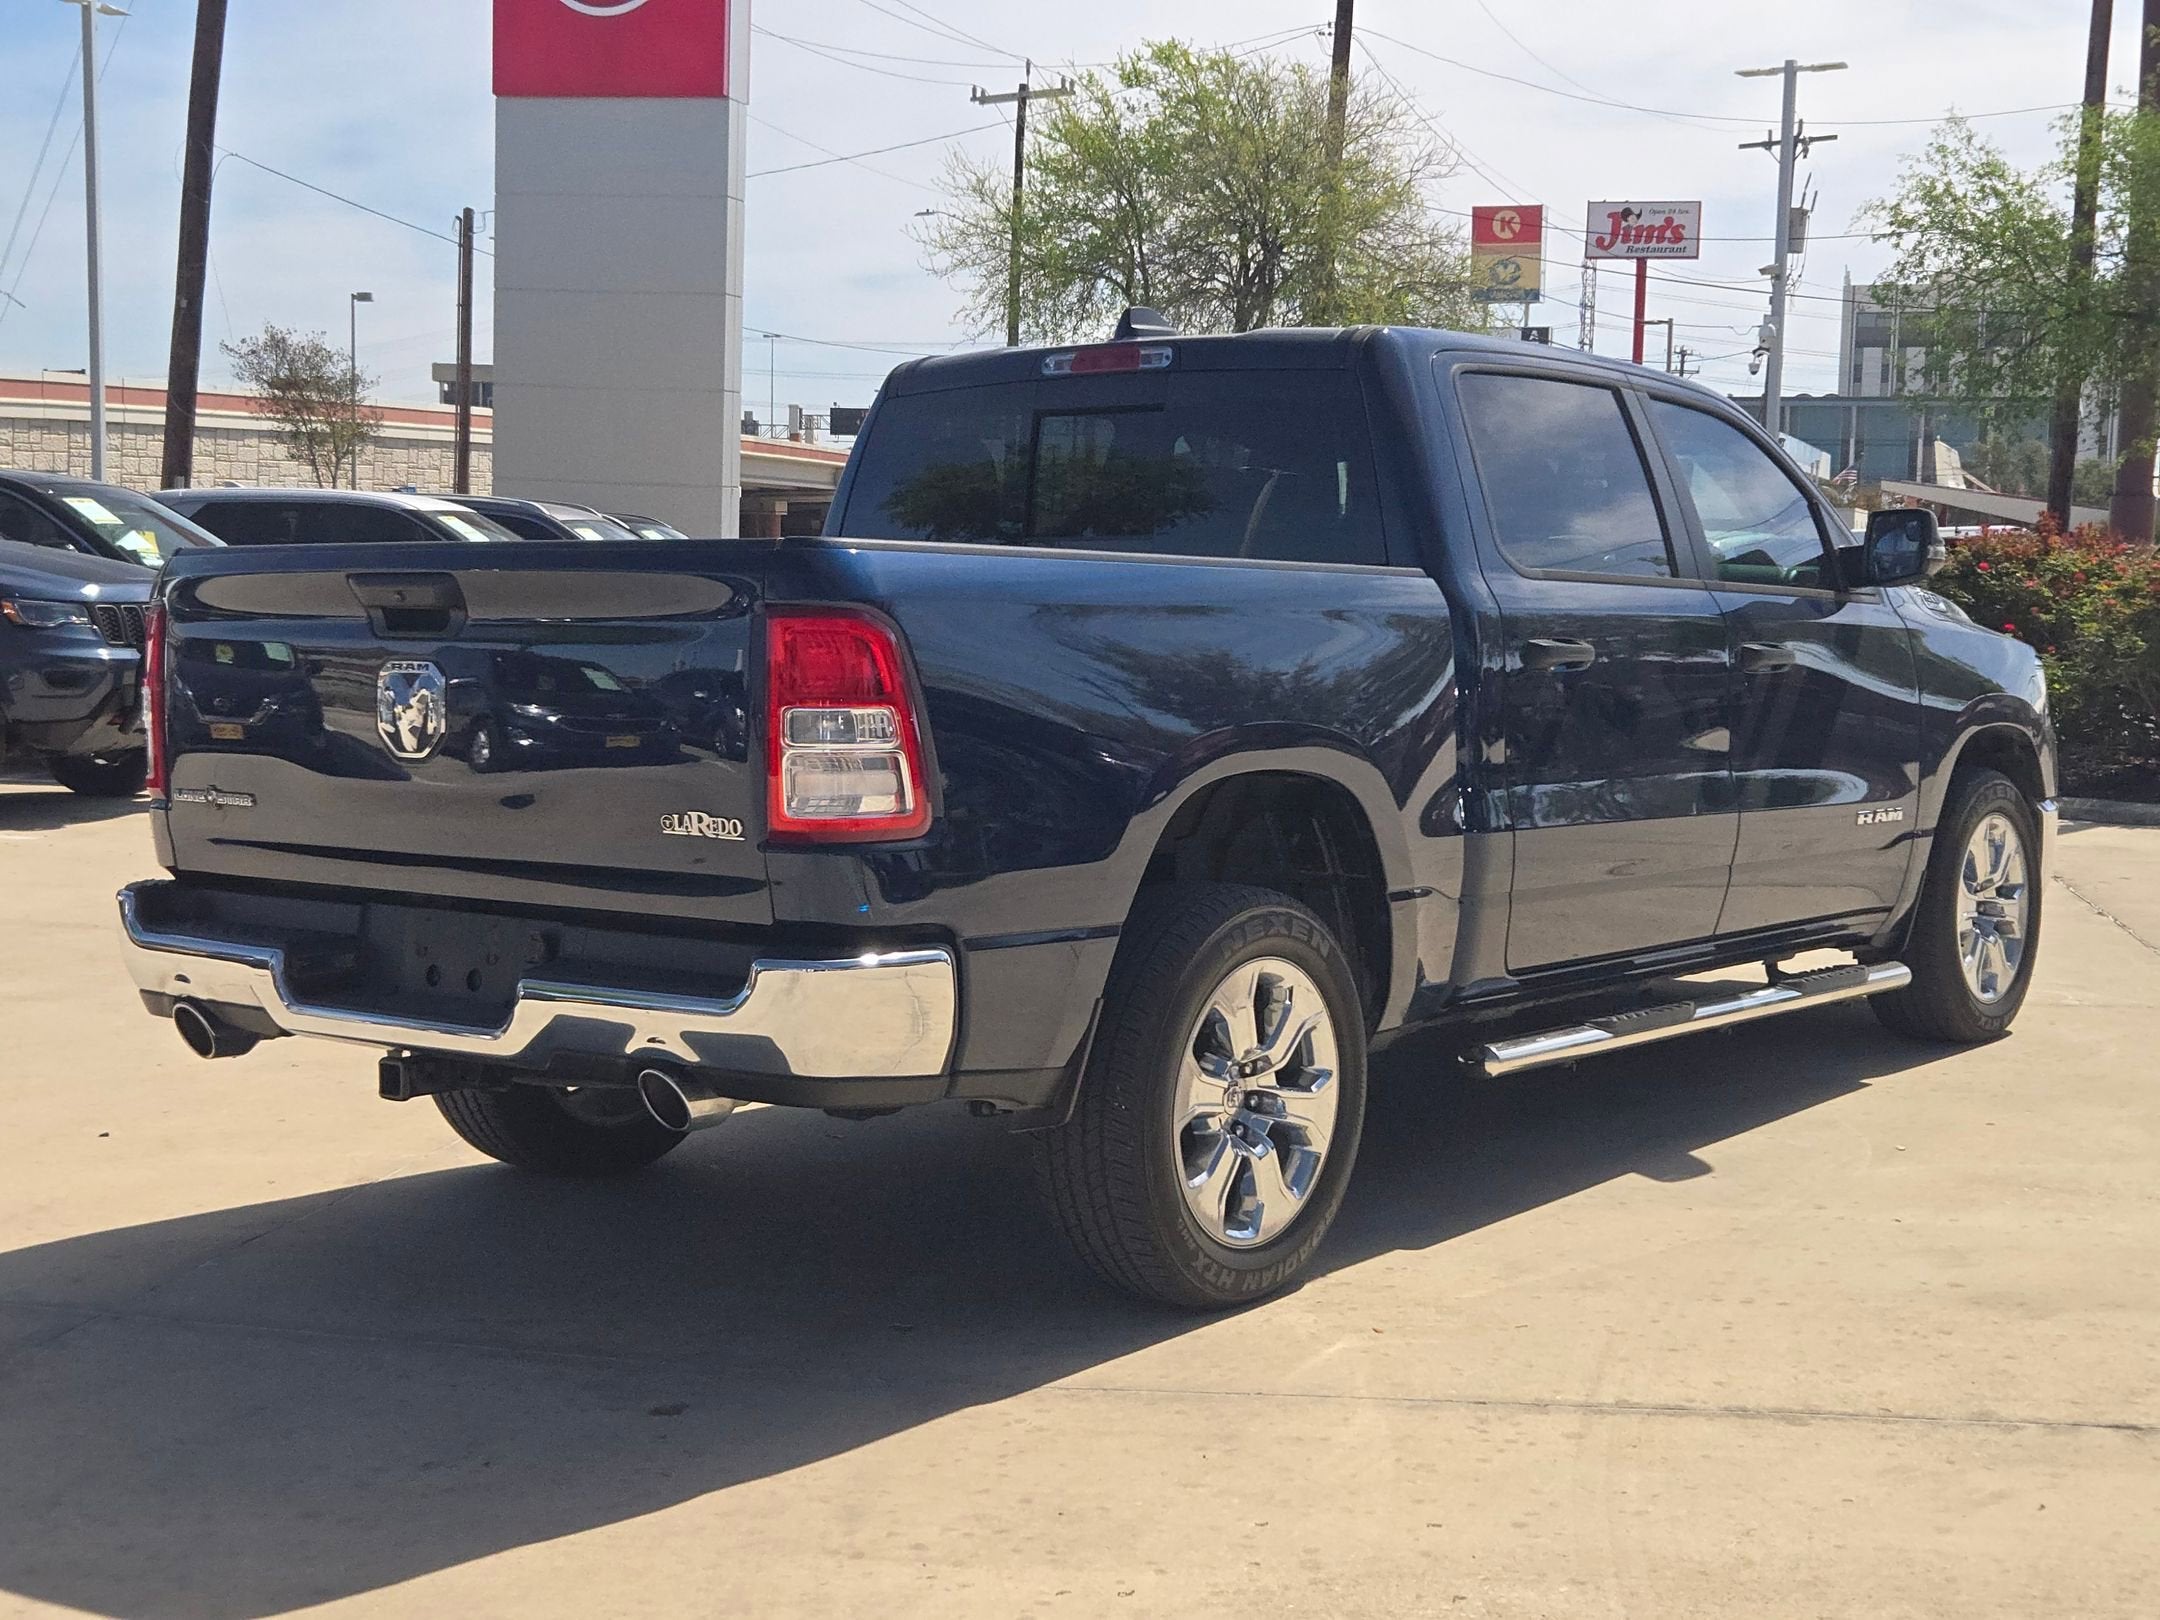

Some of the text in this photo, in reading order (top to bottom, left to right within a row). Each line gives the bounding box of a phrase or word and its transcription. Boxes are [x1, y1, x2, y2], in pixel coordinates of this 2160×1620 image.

[1500, 215, 1517, 238] K
[1595, 210, 1686, 251] Jim's
[1625, 245, 1688, 254] Restaurant
[391, 663, 430, 671] RAM
[671, 811, 743, 838] LAREDO
[1856, 807, 1904, 825] RAM
[1220, 910, 1330, 961] NEXEN
